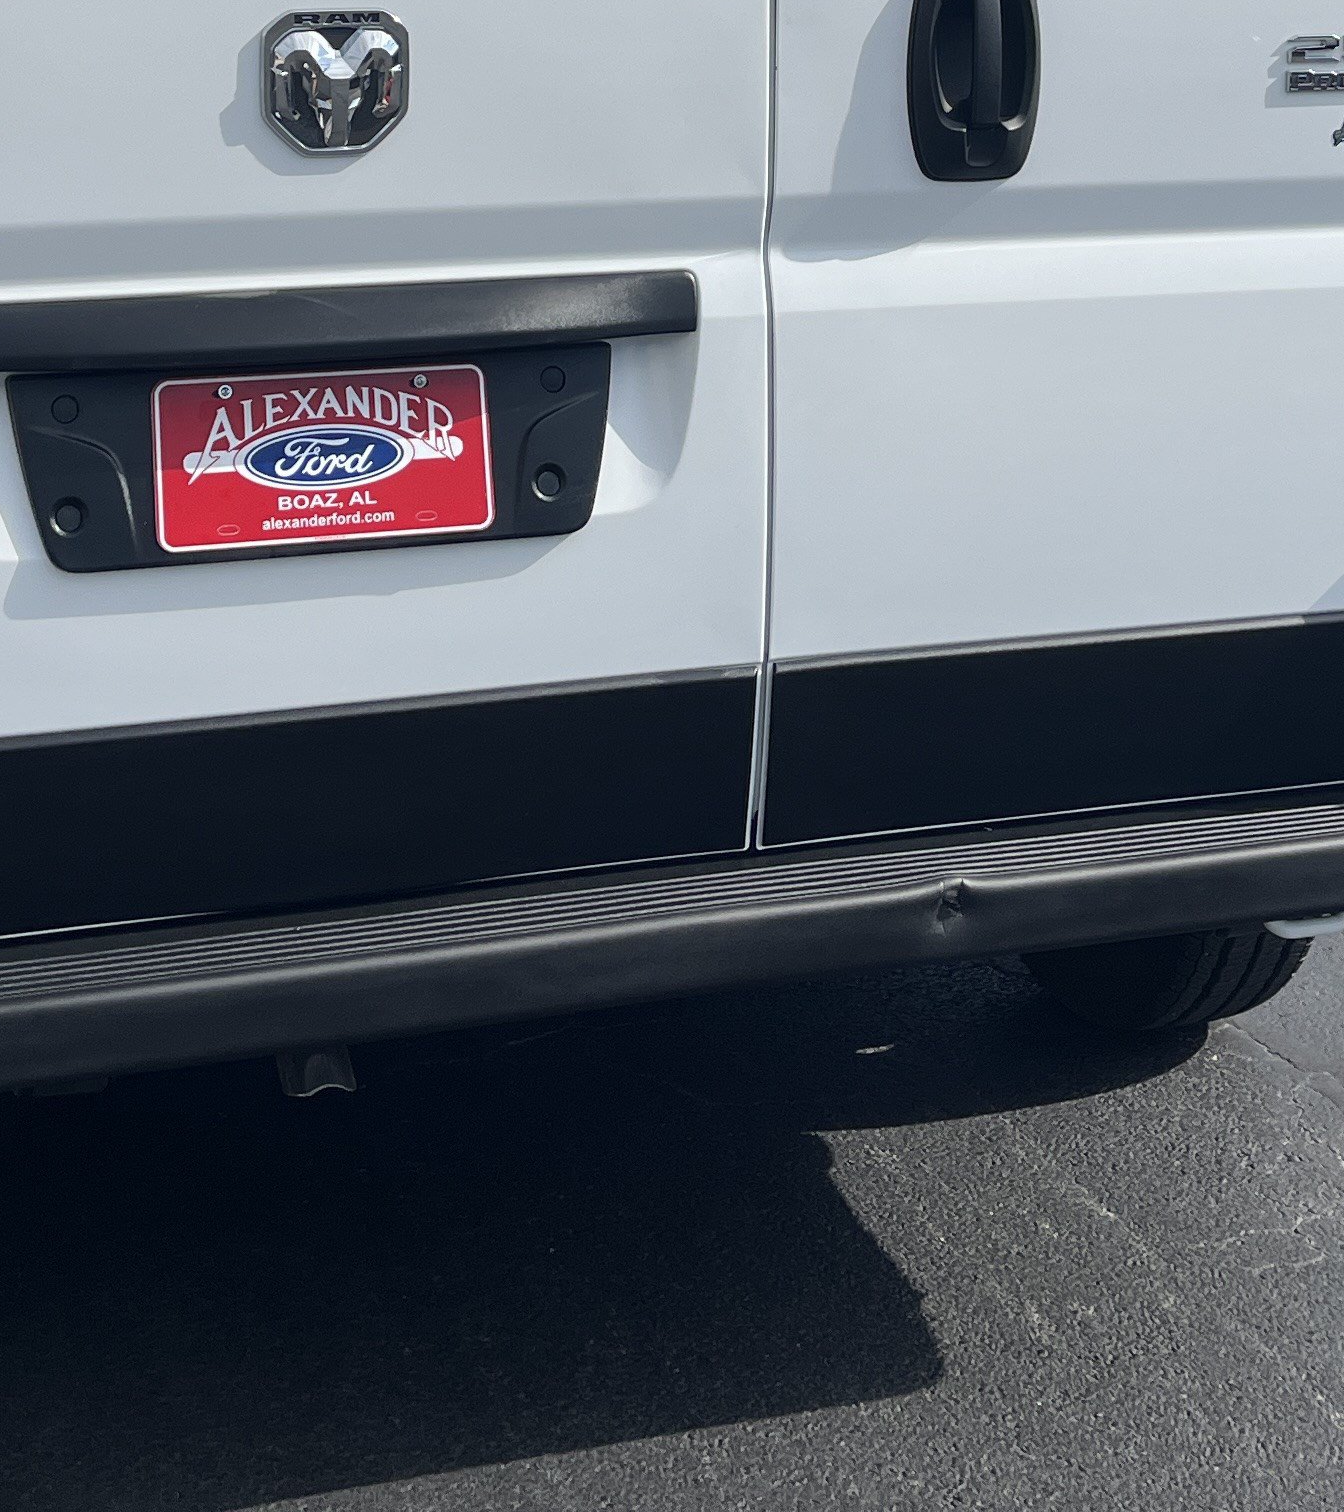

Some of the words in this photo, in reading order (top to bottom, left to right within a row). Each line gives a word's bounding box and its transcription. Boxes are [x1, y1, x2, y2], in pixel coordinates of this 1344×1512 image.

[293, 12, 382, 26] RAM
[188, 385, 456, 485] ALEXANDER
[274, 437, 374, 478] Ford
[277, 491, 345, 511] BOAZ,
[349, 490, 378, 506] AL
[261, 509, 396, 531] alexanderford.com
